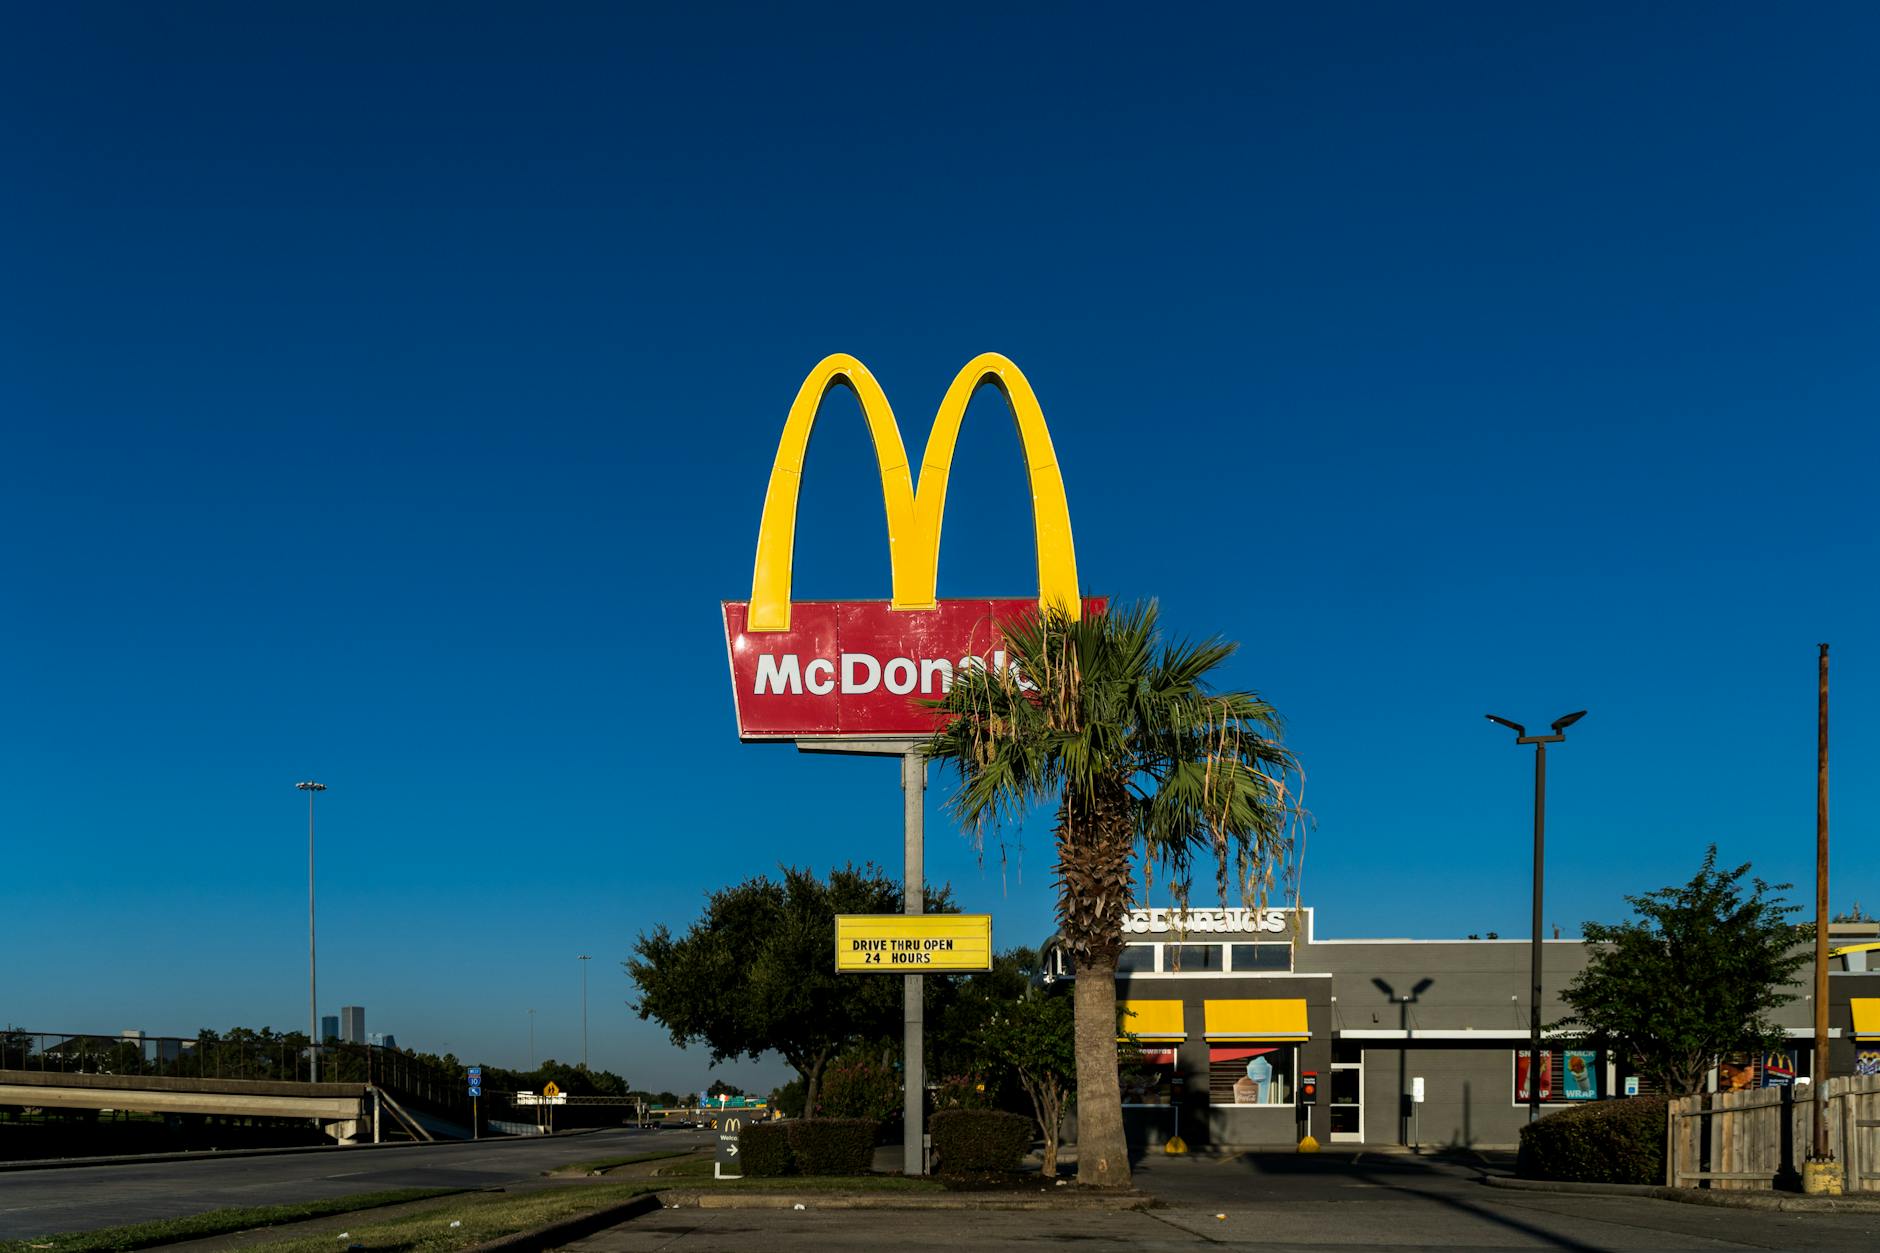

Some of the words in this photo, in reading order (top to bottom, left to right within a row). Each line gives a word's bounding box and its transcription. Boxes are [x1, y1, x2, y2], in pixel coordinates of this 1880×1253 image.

[853, 940, 887, 951] DRIVE
[891, 939, 920, 950] THRU
[923, 939, 953, 950] OPEN
[865, 953, 881, 963] 24
[891, 953, 931, 963] HOURS
[1519, 1090, 1549, 1098] WP
[1566, 1090, 1595, 1098] WRAP
